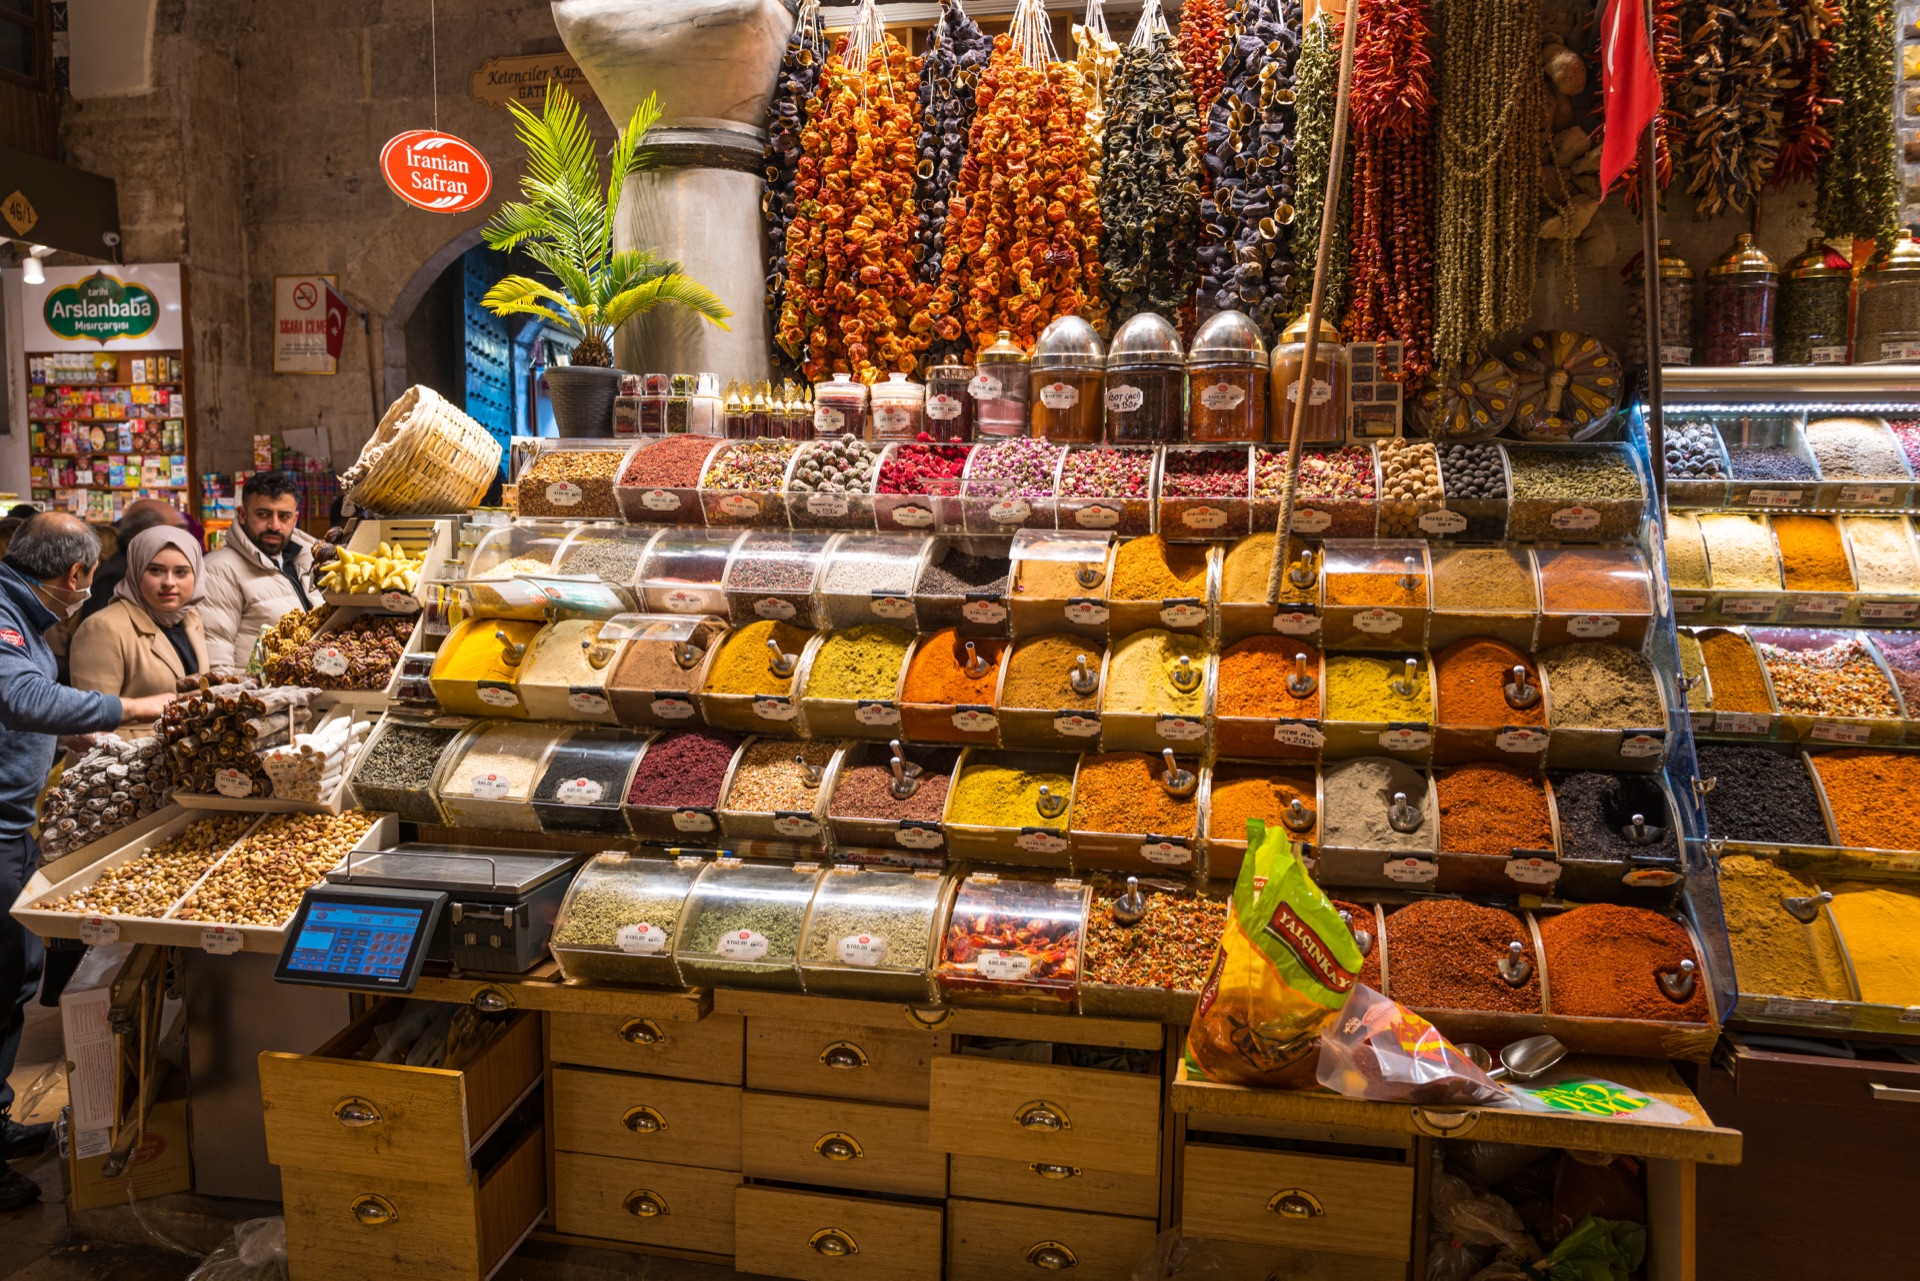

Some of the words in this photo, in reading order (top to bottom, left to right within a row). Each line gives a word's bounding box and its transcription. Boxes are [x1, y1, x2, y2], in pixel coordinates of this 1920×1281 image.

[487, 65, 549, 85] Ketenciler
[552, 65, 586, 84] Kapı
[411, 171, 468, 195] Safran
[9, 202, 32, 224] 46/1
[88, 288, 109, 297] tarihi
[52, 298, 152, 319] Arslanbaba
